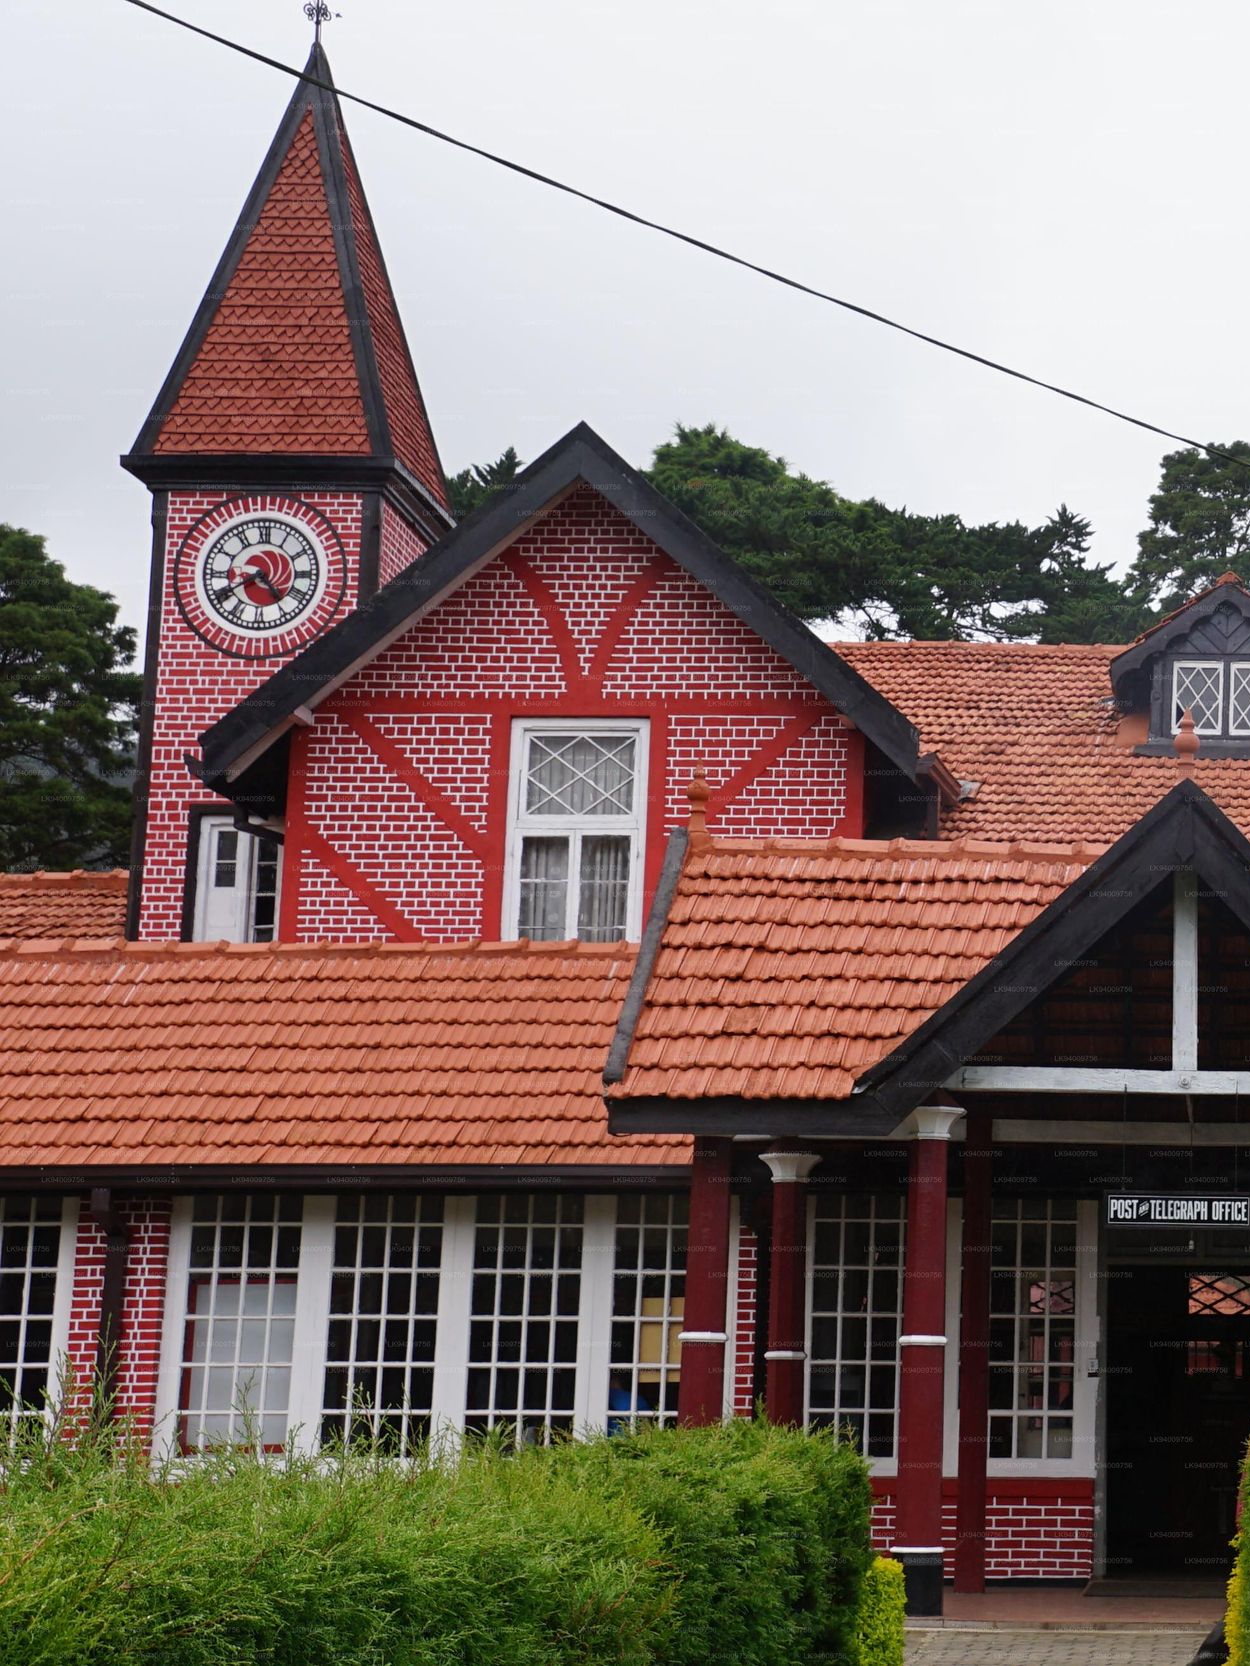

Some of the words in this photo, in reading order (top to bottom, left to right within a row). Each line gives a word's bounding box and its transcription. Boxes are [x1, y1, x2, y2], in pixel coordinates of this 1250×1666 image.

[1110, 1199, 1138, 1219] POST
[1150, 1200, 1208, 1220] TELEGRAPH
[1212, 1201, 1248, 1221] OFFICE
